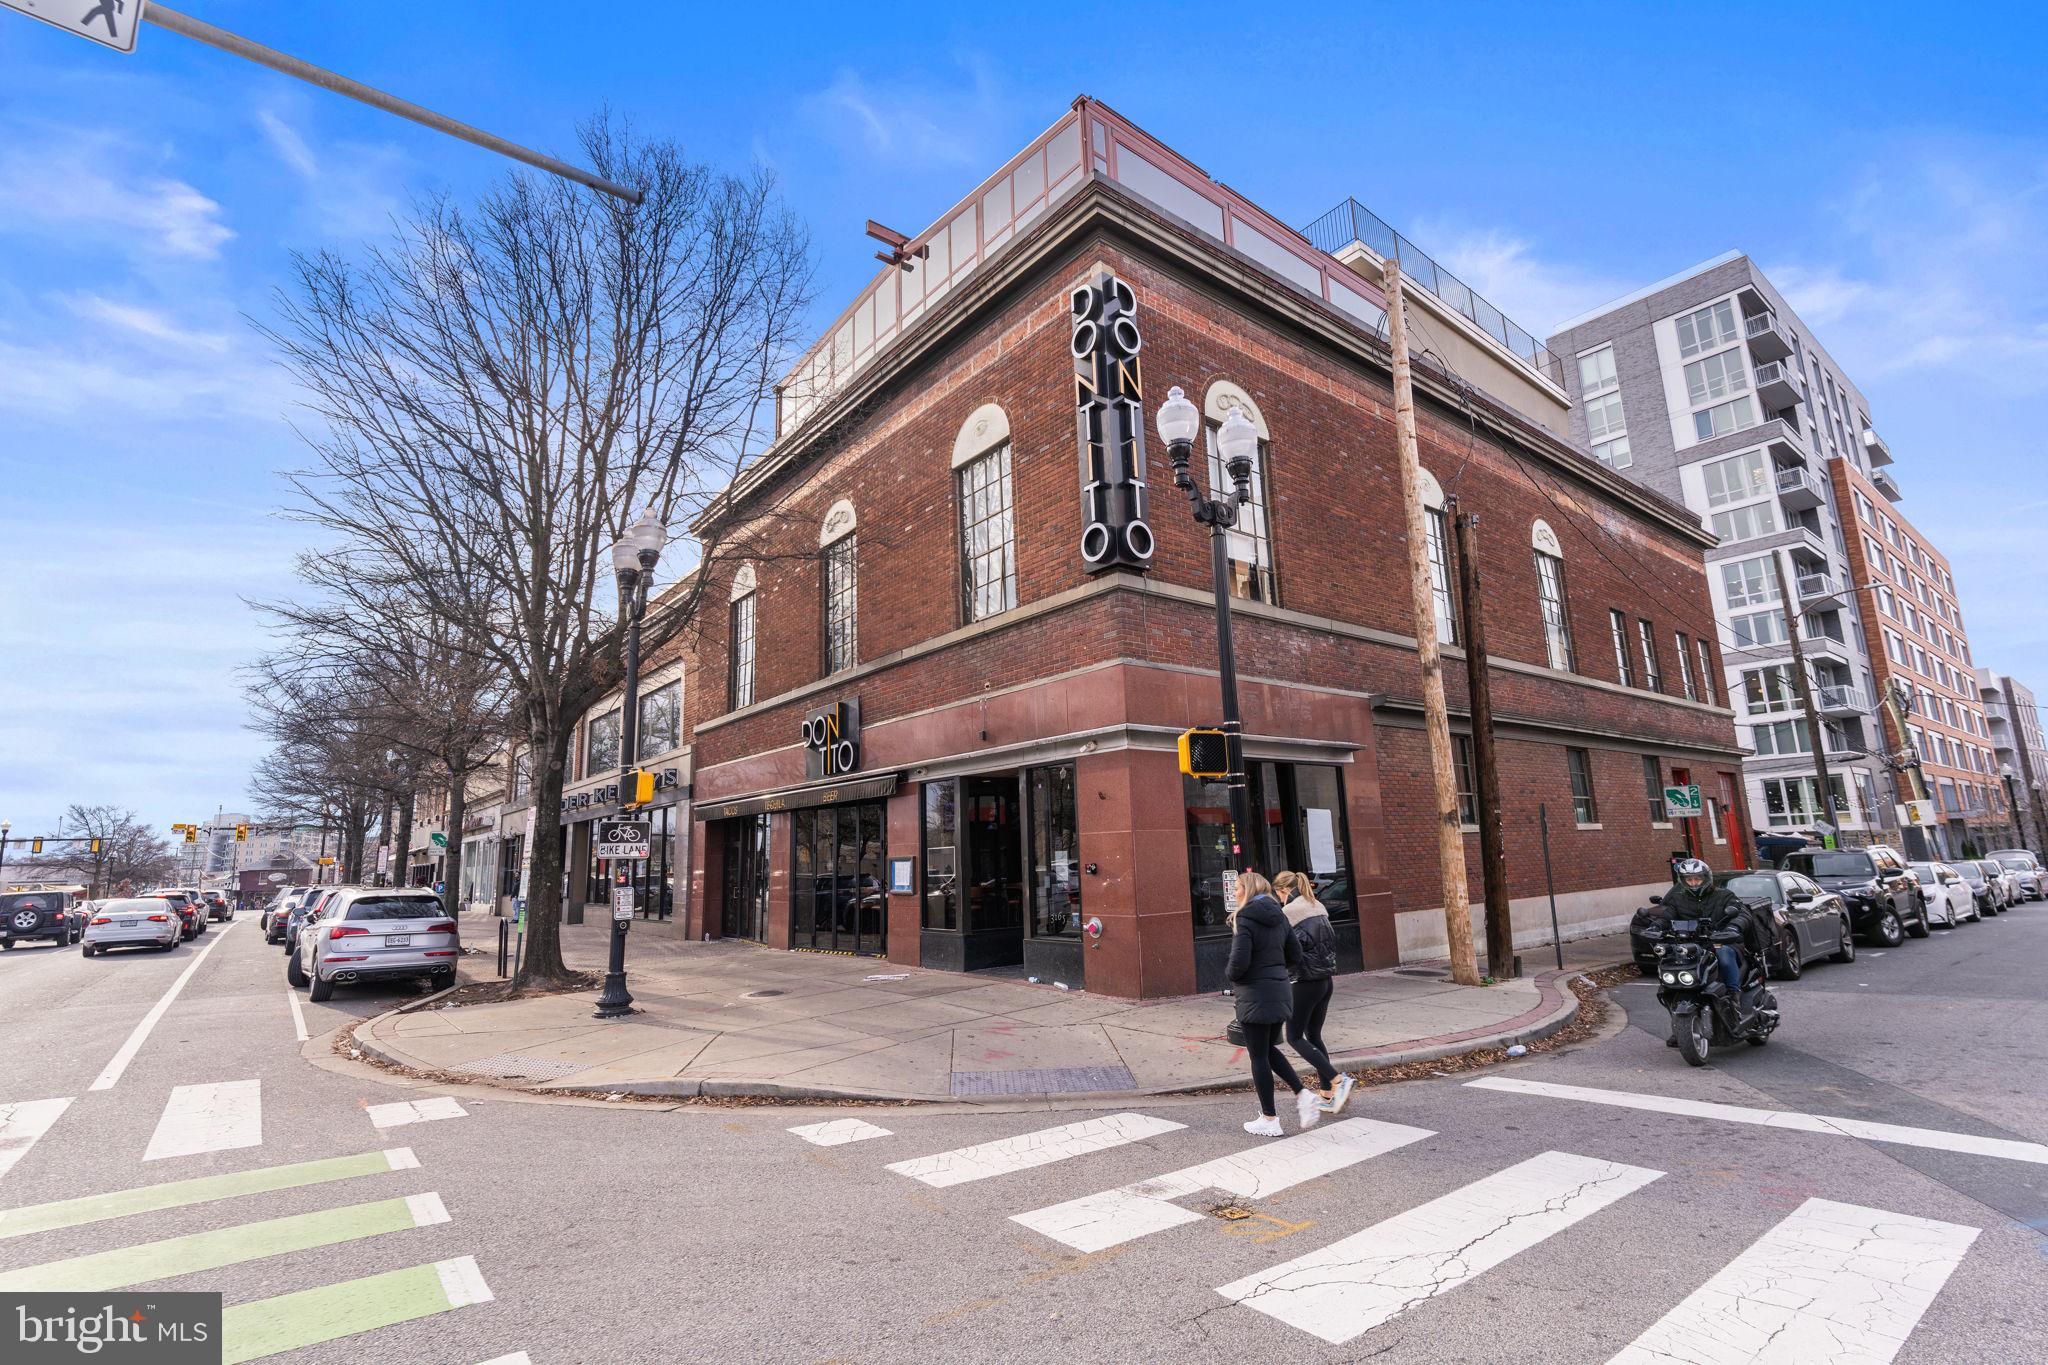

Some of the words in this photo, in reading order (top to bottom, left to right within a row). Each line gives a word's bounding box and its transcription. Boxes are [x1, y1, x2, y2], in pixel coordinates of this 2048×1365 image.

[1070, 284, 1098, 406] DON
[1112, 276, 1143, 401] DON
[1079, 399, 1110, 563] TITO
[1122, 397, 1155, 559] TITO
[801, 702, 839, 748] DON
[819, 740, 854, 775] TITO
[560, 792, 589, 812] DER
[723, 806, 738, 817] TACOS
[764, 798, 786, 811] TEQUILA
[822, 789, 840, 803] BEER
[600, 845, 620, 855] BIKE
[1050, 911, 1066, 924] 3165
